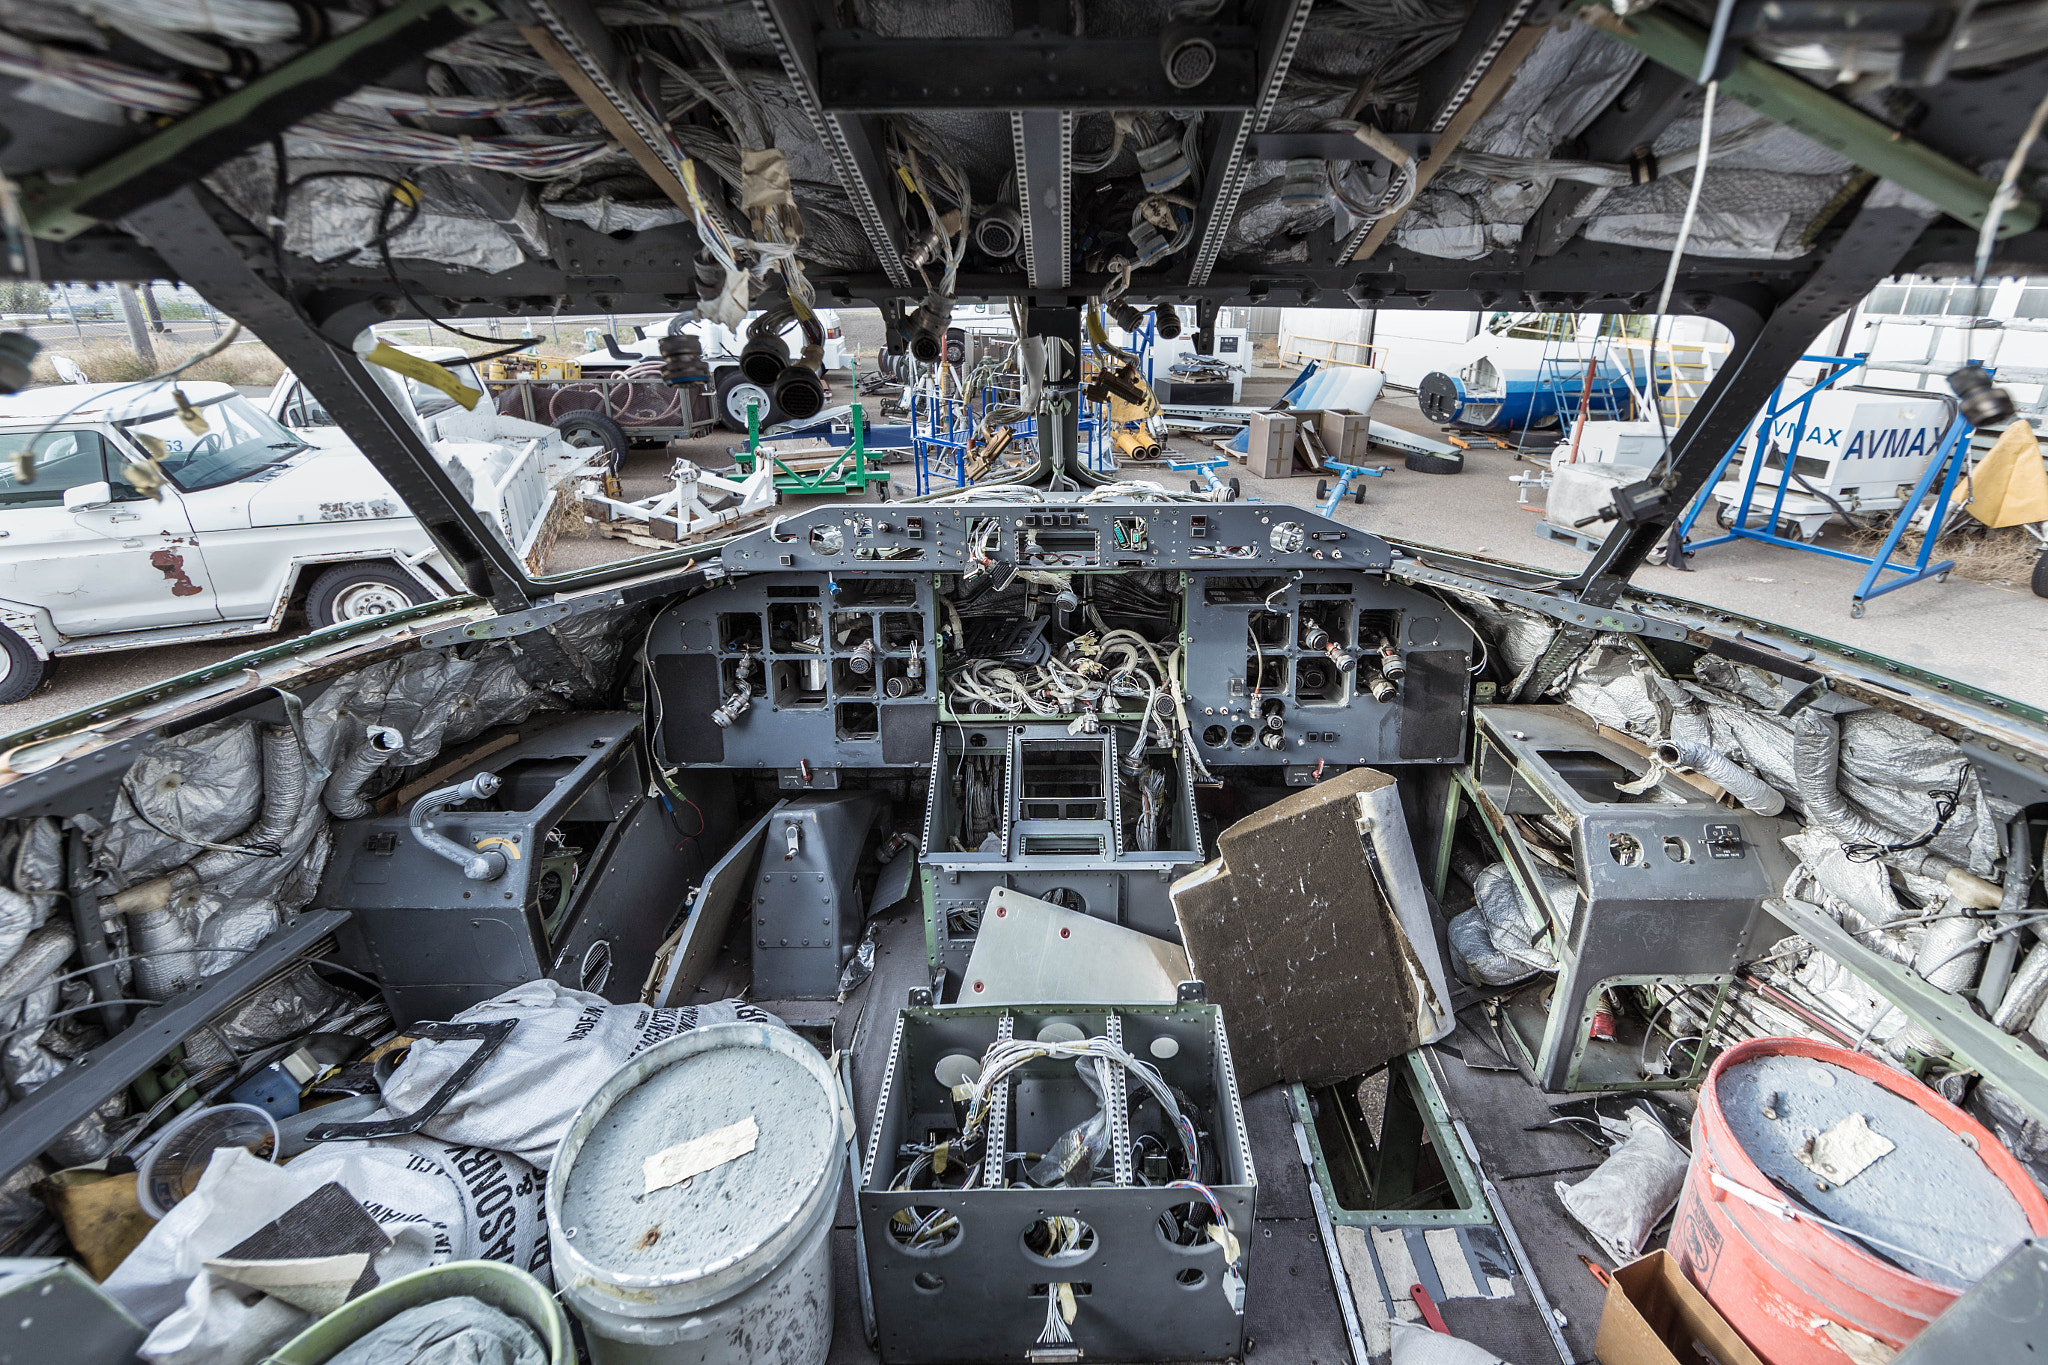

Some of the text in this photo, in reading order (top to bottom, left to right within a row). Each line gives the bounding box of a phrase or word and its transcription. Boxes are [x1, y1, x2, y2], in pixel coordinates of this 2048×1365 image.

[1759, 420, 1842, 447] VMAX
[563, 1005, 604, 1043] MADE IN
[444, 1145, 517, 1264] ASONRY
